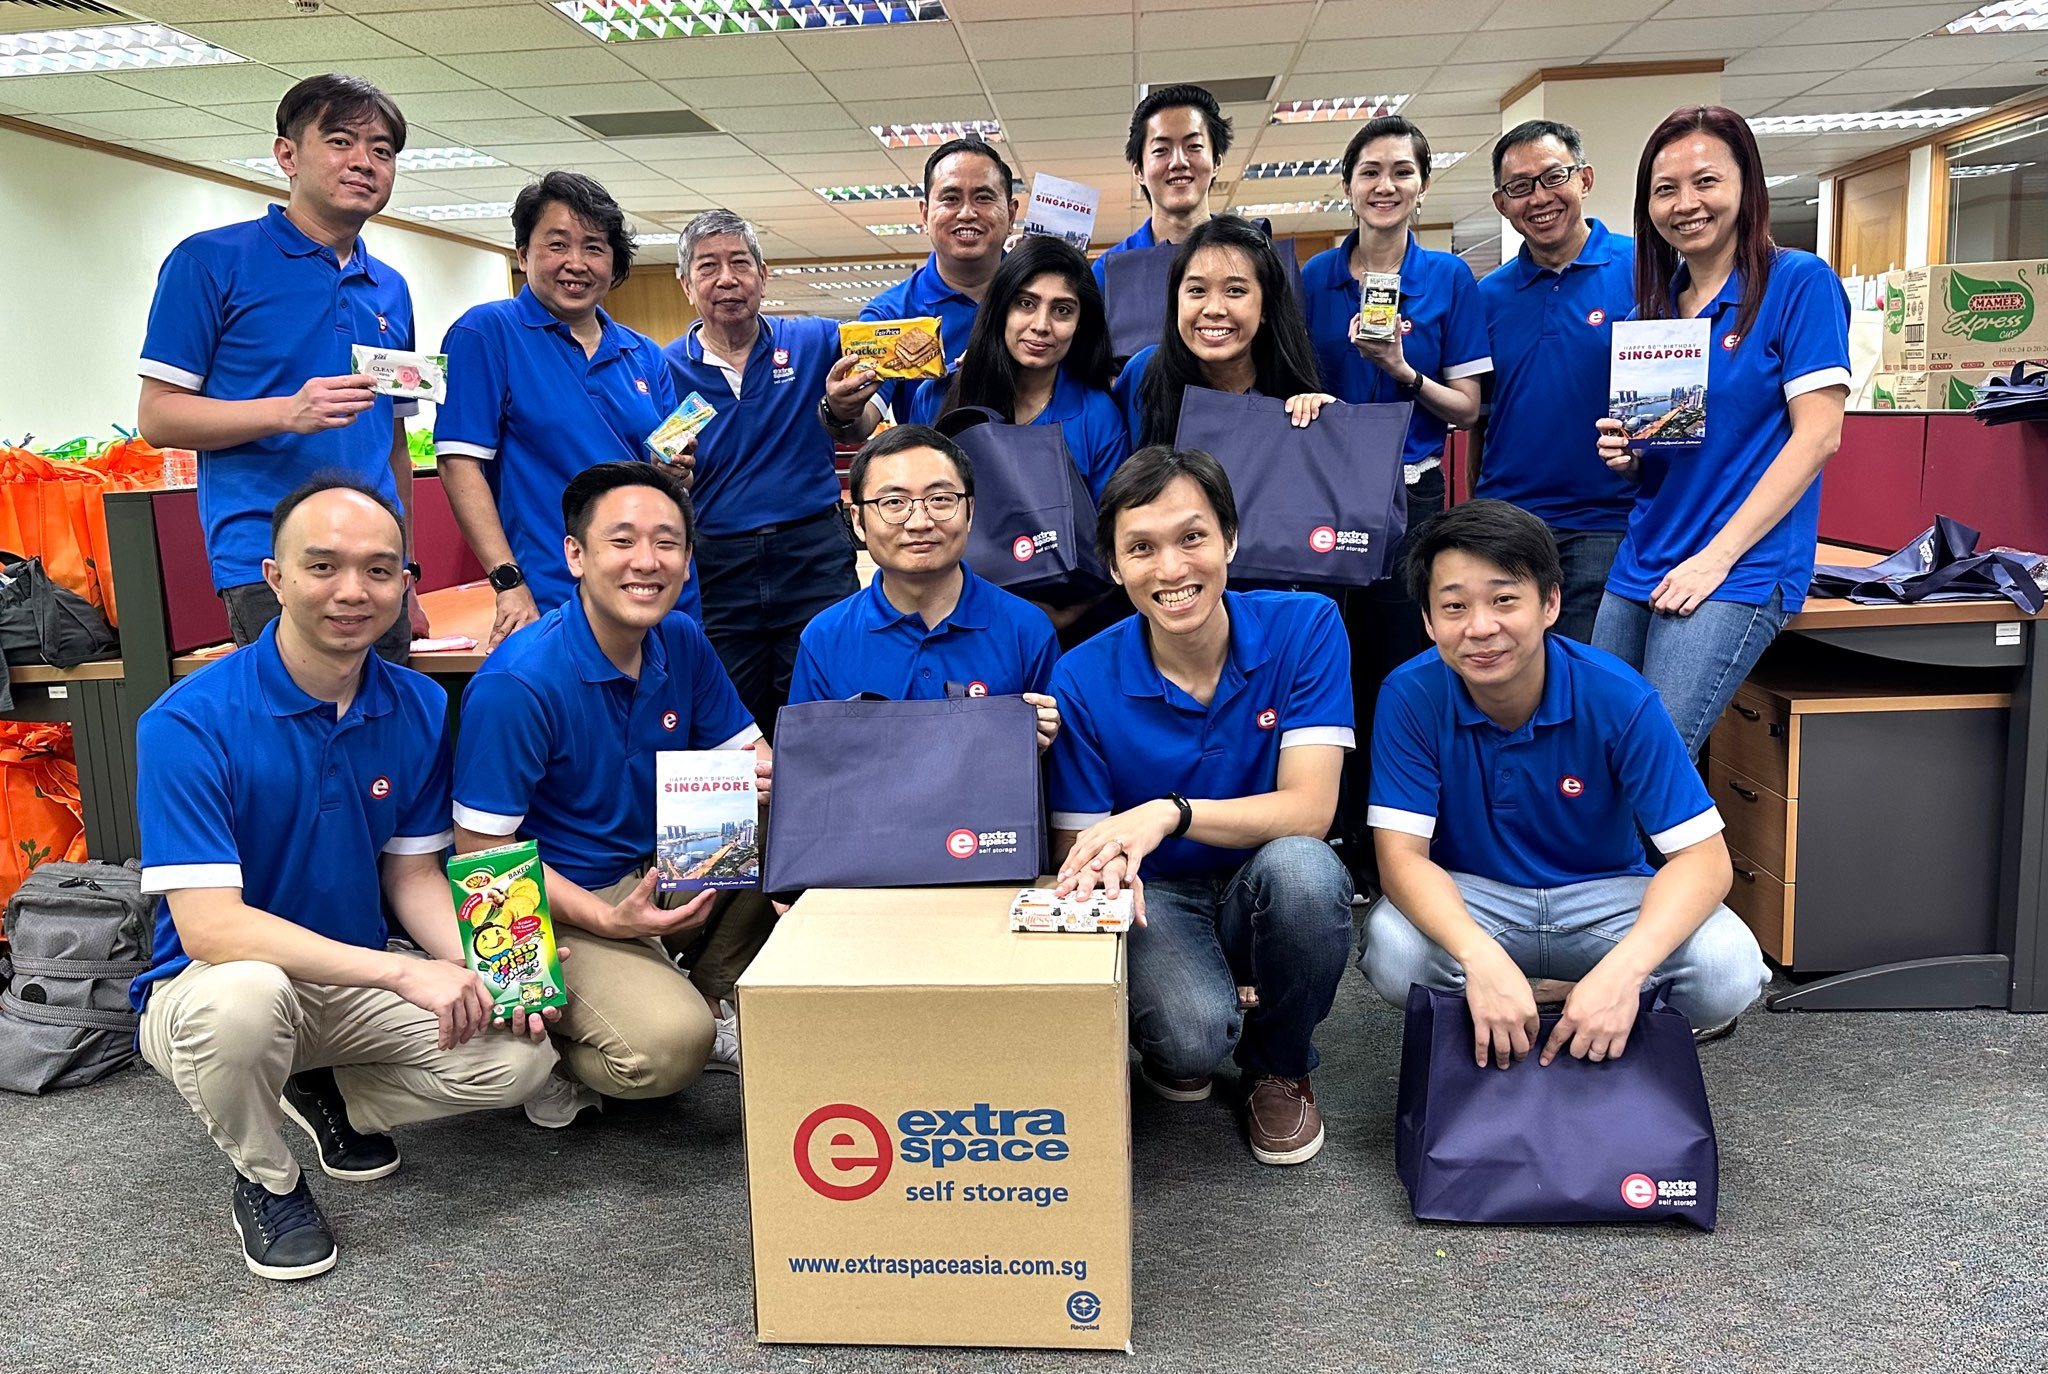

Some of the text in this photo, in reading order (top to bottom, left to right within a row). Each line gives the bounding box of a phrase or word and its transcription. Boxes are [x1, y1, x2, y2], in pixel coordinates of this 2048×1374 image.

[1035, 194, 1092, 215] SINGAPORE
[2037, 263, 2048, 275] PE
[1976, 298, 2017, 307] MAMEE
[1942, 309, 2024, 340] Express
[1999, 329, 2018, 338] CUP
[845, 346, 887, 356] Crackers
[1618, 349, 1702, 360] SINGAPORE
[1337, 530, 1369, 540] extra
[1337, 537, 1369, 545] space
[1259, 710, 1276, 728] e
[371, 777, 390, 797] e
[664, 782, 749, 793] SINGAPORE
[1562, 777, 1582, 794] e
[979, 830, 1017, 839] extra
[979, 838, 1017, 847] space
[507, 864, 531, 880] BAKED
[543, 986, 553, 998] 8
[897, 1103, 1067, 1136] extra
[797, 1107, 1070, 1197] e space
[1658, 1180, 1697, 1190] extra
[906, 1180, 1069, 1208] self storage
[1658, 1188, 1697, 1198] space
[788, 1254, 1087, 1281] www.extraspaceasia.com.sg
[1070, 1323, 1099, 1332] Recycled
